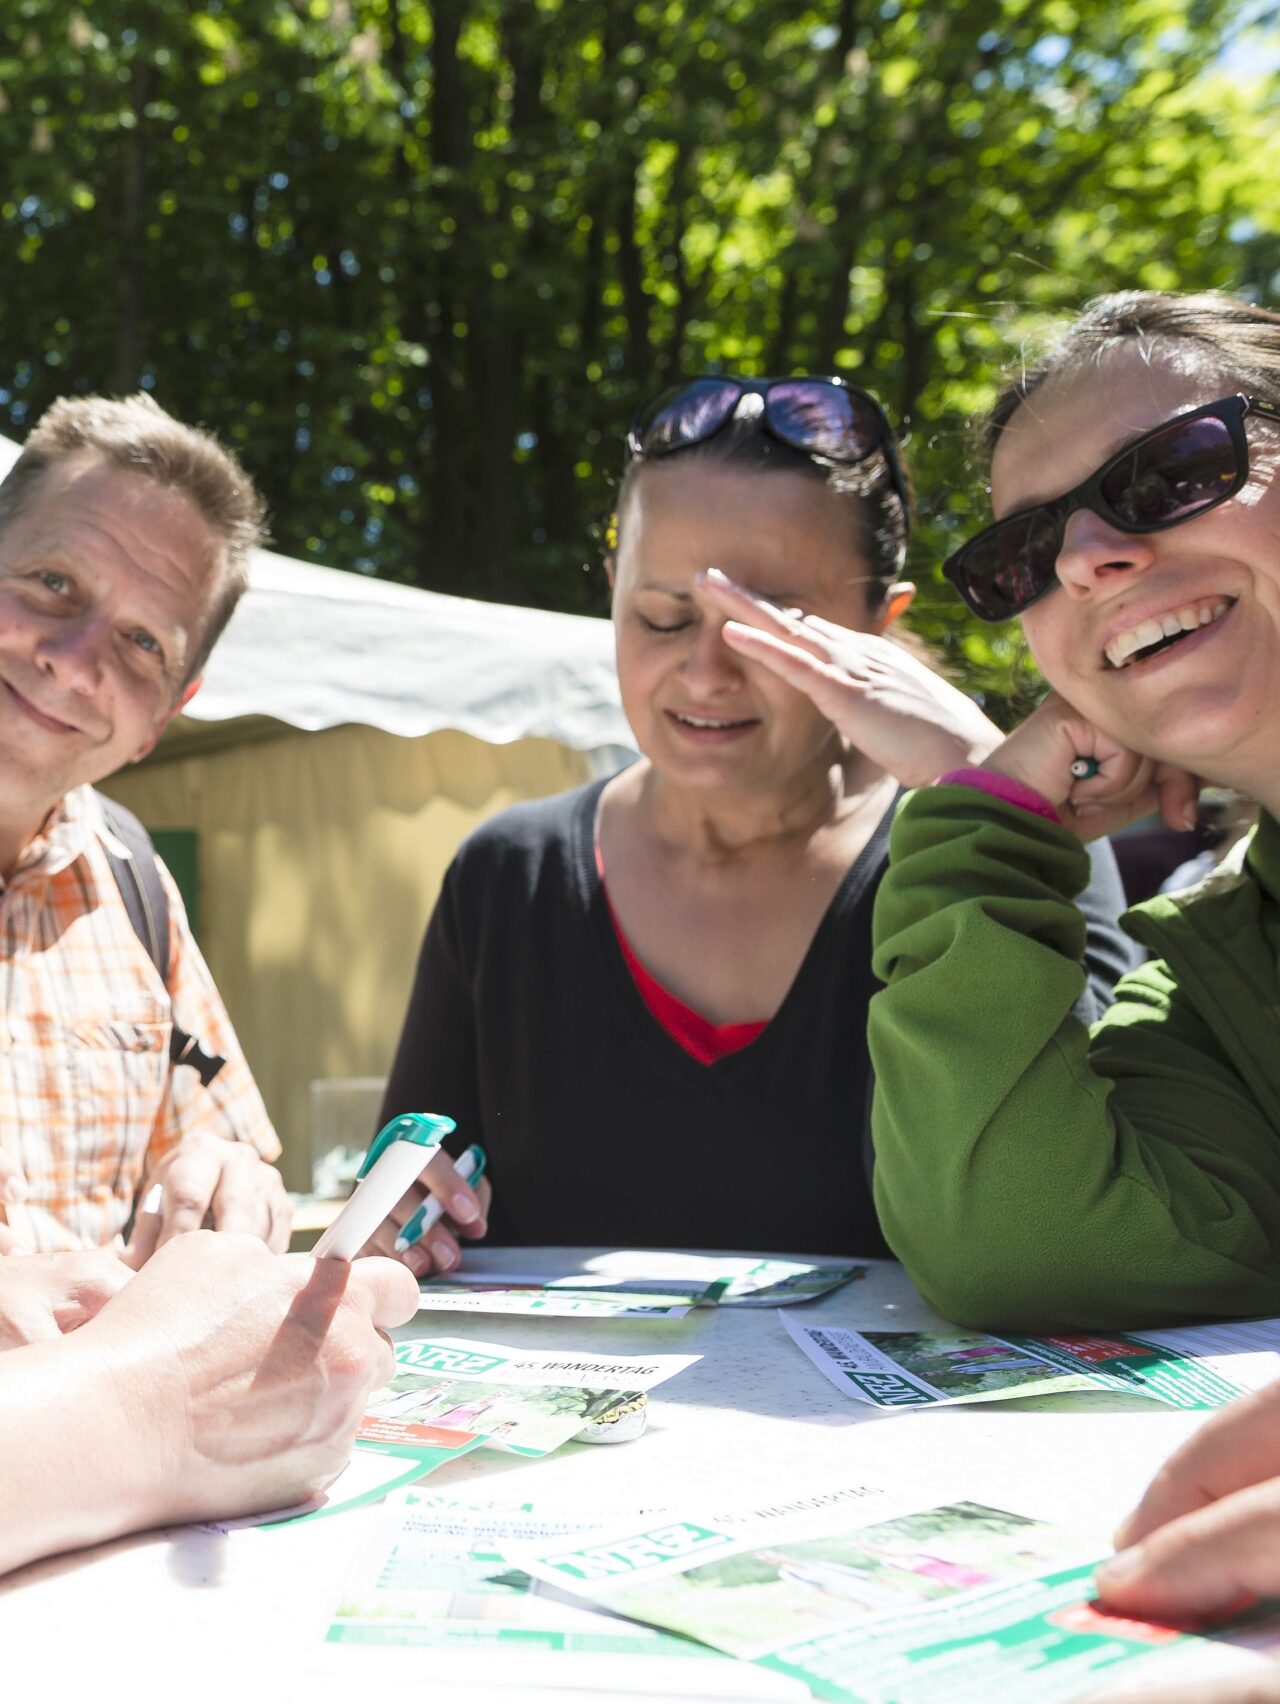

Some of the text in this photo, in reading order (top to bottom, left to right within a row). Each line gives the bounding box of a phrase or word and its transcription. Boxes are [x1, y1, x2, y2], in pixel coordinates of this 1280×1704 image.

[395, 1343, 503, 1374] NRZ
[541, 1361, 660, 1375] WANDERTAG
[852, 1374, 931, 1405] NRZ
[541, 1524, 728, 1580] NRZ
